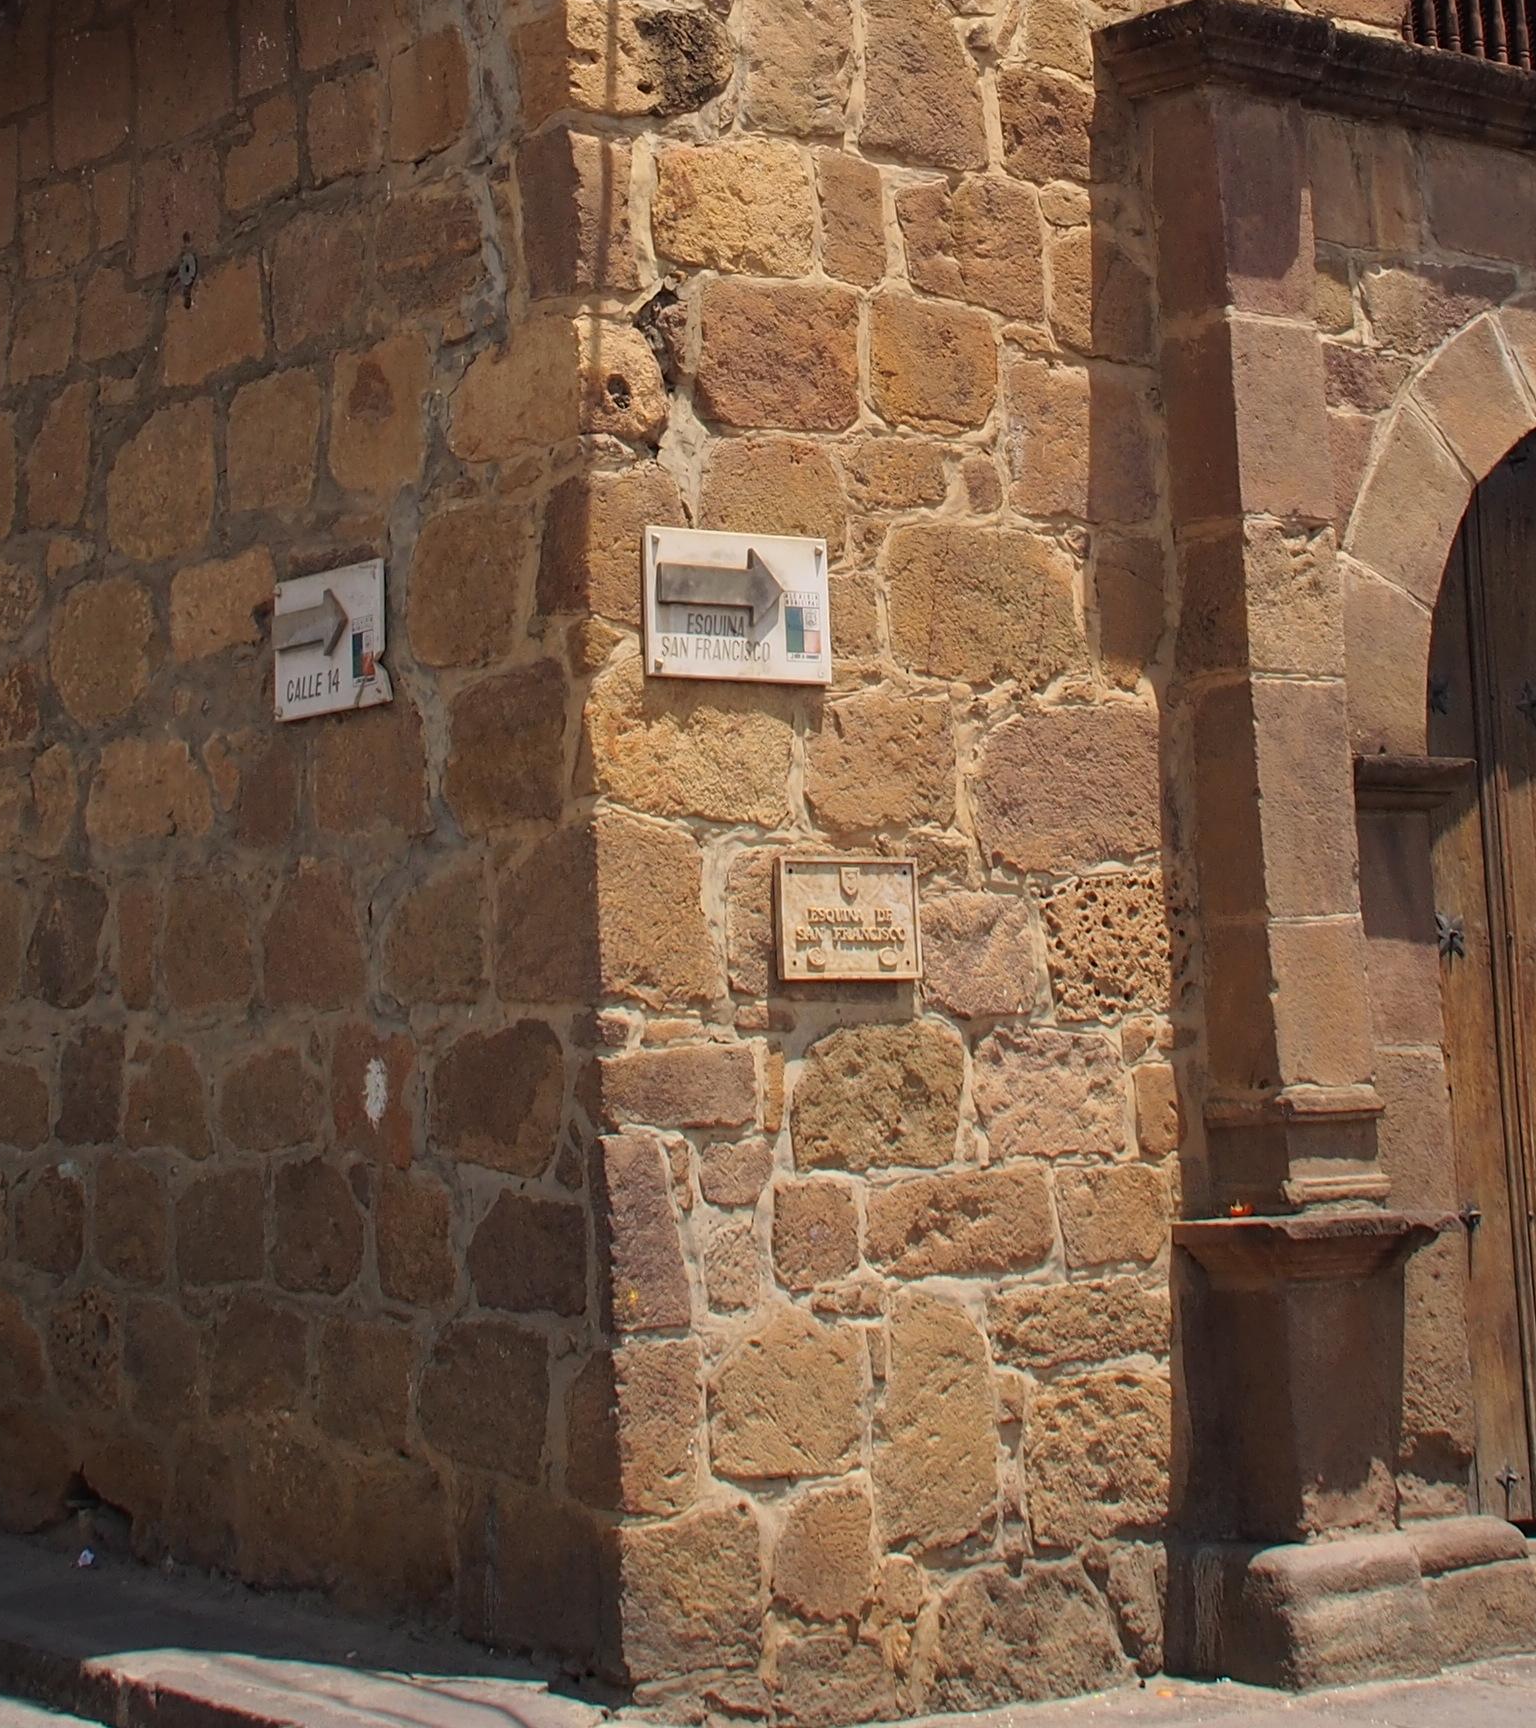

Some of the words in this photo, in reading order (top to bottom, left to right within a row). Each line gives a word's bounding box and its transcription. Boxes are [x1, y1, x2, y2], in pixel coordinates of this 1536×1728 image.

[686, 613, 745, 637] ESQUINA
[661, 636, 689, 658] SAN
[695, 638, 771, 663] FRANCISCO
[287, 673, 323, 703] CALLE
[327, 668, 339, 694] 14
[808, 908, 863, 923] ESQUINA
[875, 908, 893, 923] DE
[795, 926, 822, 941] SAN
[831, 927, 906, 942] FRANCISCO
